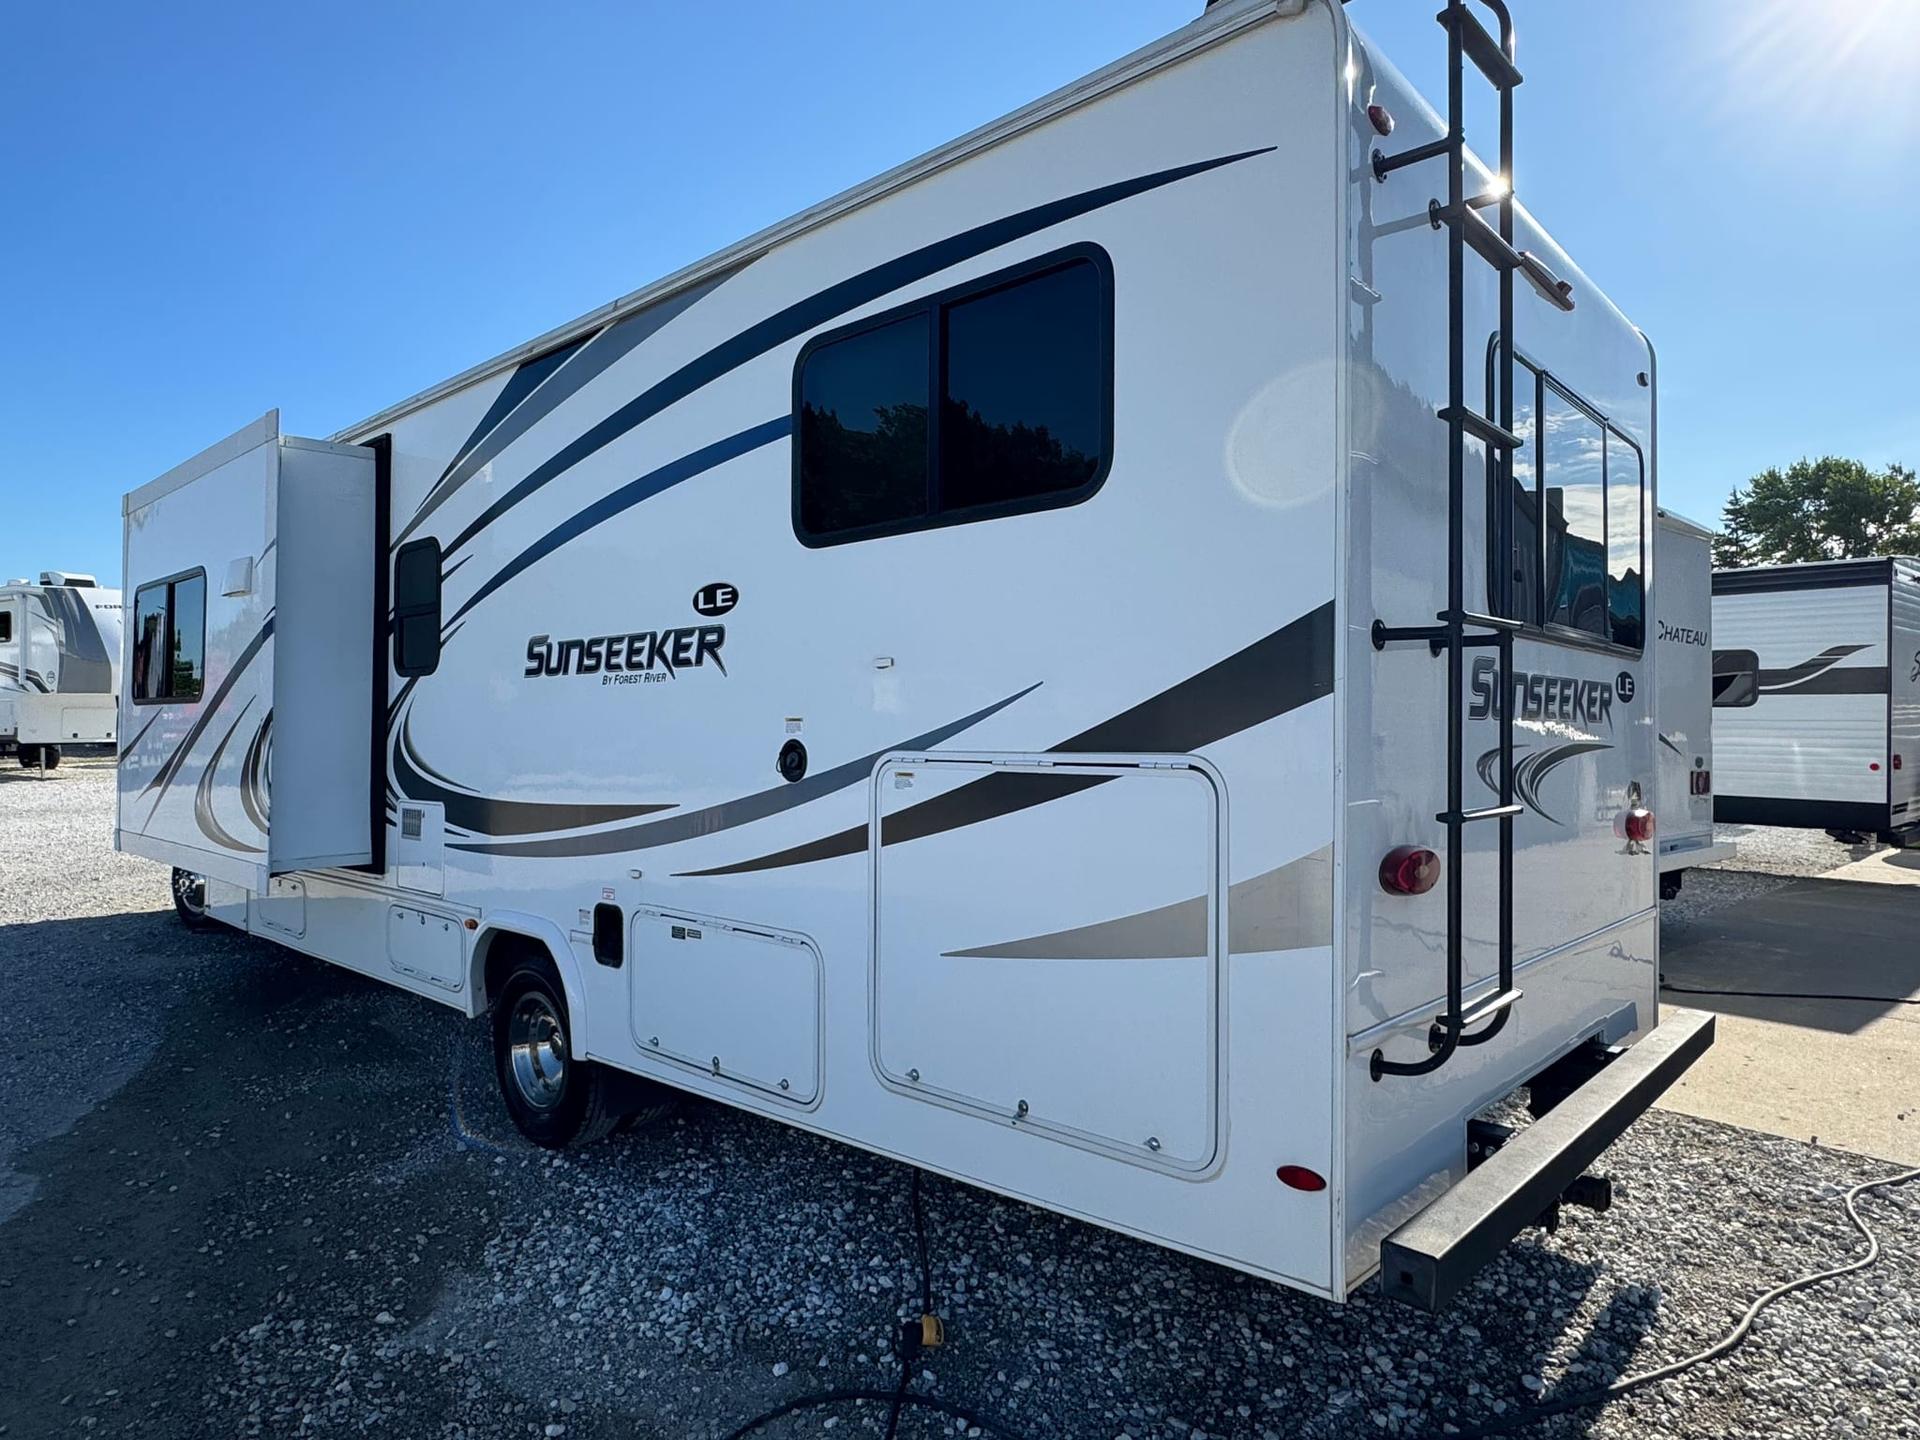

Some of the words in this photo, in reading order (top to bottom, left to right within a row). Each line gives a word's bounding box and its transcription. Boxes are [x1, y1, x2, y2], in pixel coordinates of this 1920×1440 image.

[698, 588, 733, 610] LE
[613, 674, 643, 685] FOREST
[643, 672, 667, 684] RIVER
[1617, 677, 1633, 695] LE
